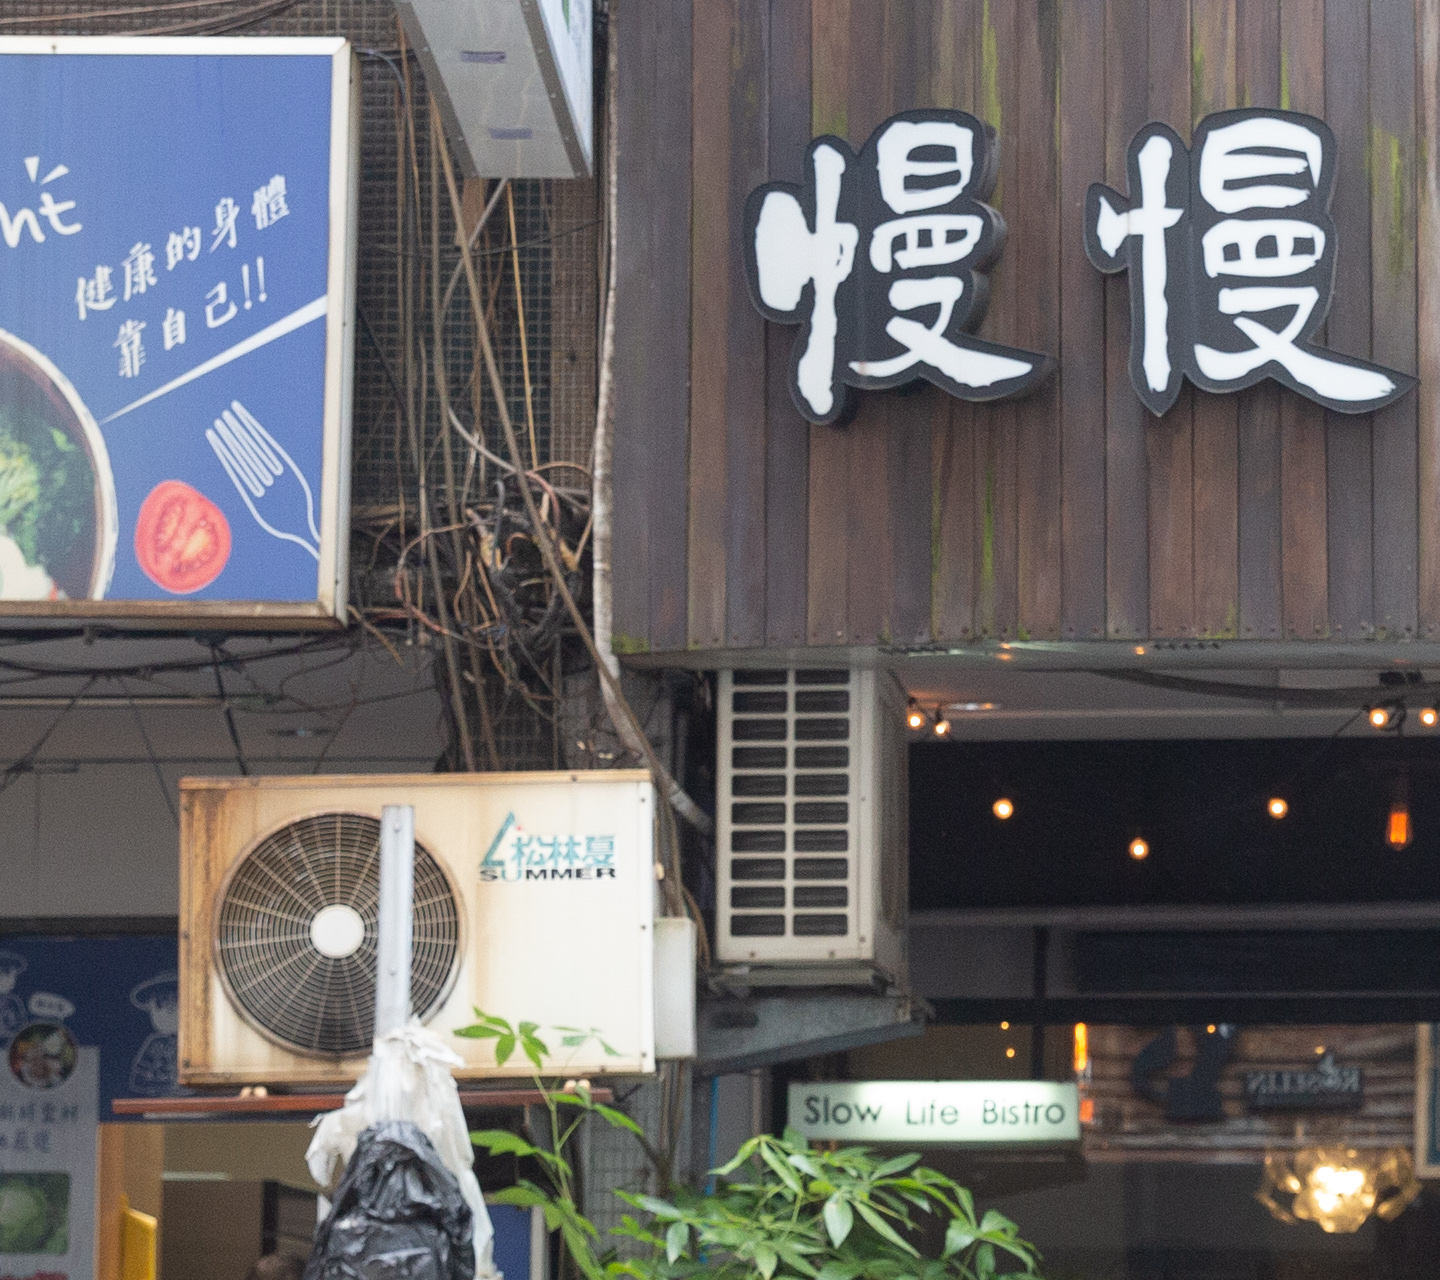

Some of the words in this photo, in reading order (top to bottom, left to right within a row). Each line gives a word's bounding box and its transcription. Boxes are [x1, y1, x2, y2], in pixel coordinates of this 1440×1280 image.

[76, 173, 292, 323] 健康的身體
[752, 115, 1398, 418] 慢慢
[479, 867, 617, 882] SUMMER
[803, 1094, 883, 1126] Slow
[905, 1098, 960, 1126] Life
[981, 1098, 1066, 1126] Bistro
